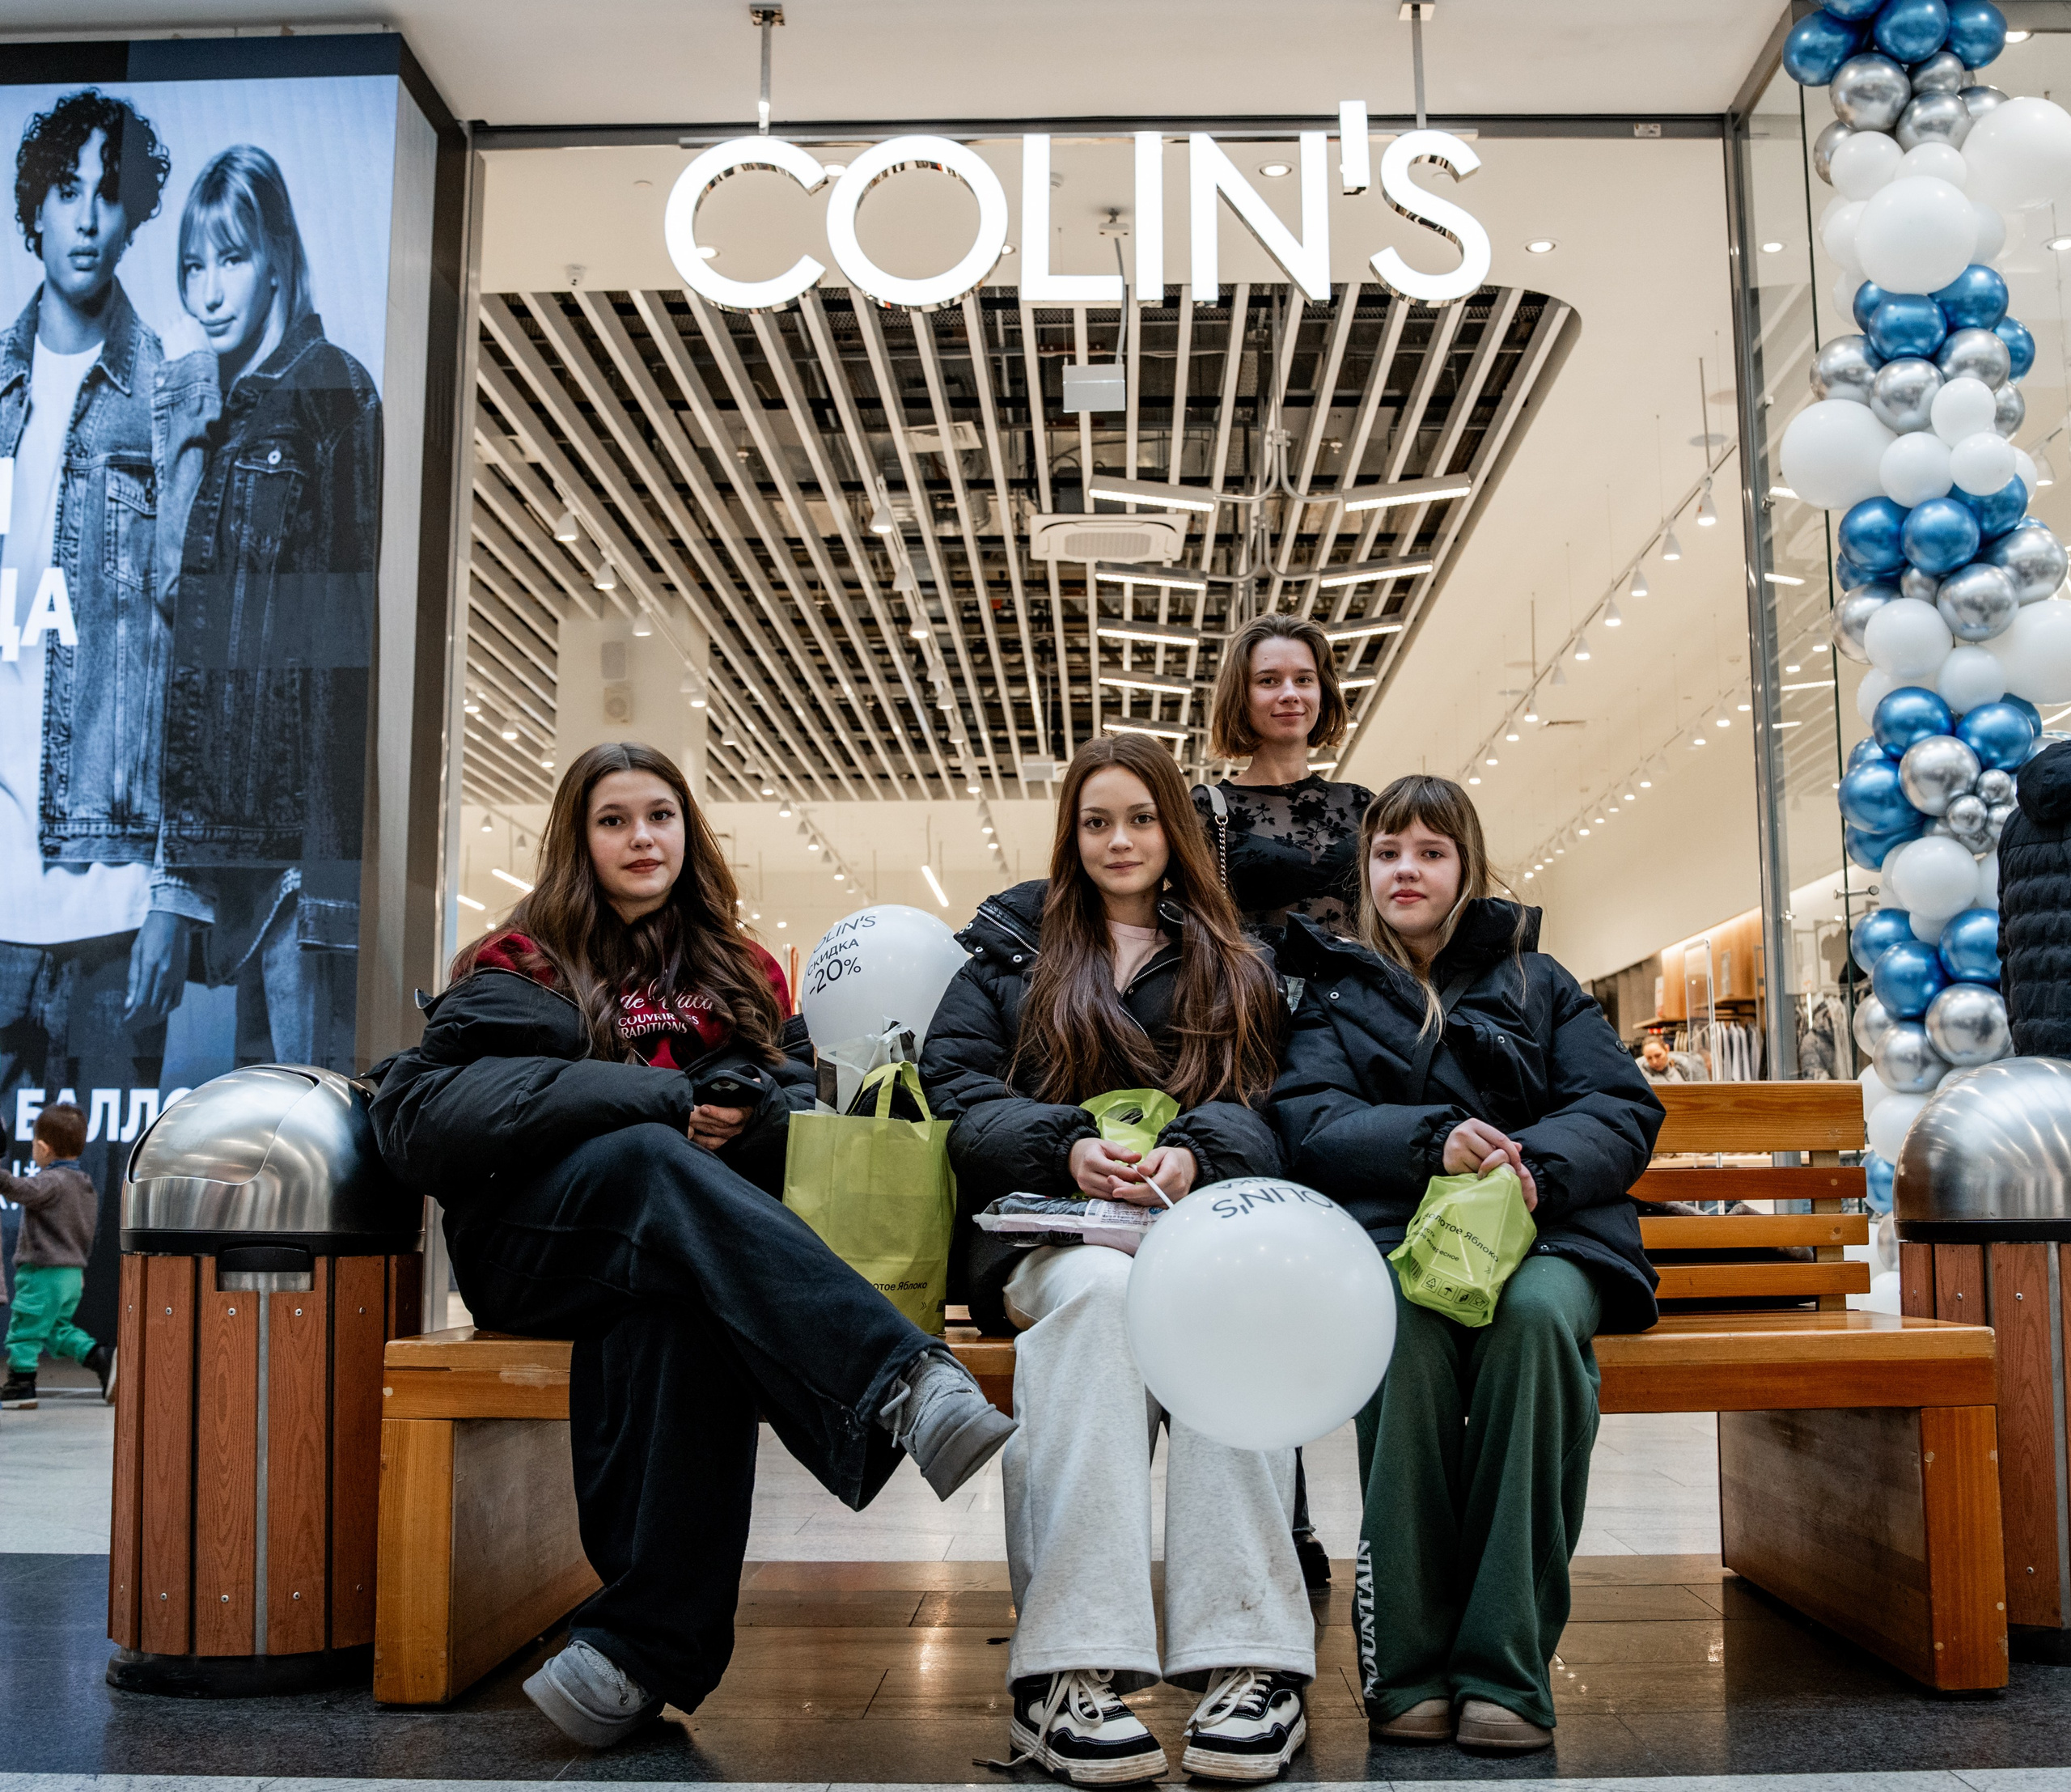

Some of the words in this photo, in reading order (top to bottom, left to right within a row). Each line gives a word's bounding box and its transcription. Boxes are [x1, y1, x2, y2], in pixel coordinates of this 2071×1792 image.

[663, 100, 1492, 311] COLIN'S
[807, 938, 859, 976] СКИДКА
[809, 956, 862, 995] -20%
[620, 1021, 688, 1039] RADITIONS
[1212, 1188, 1355, 1219] OLIN'S
[1464, 1231, 1499, 1263] Яблоко
[896, 1281, 928, 1291] Яблоко
